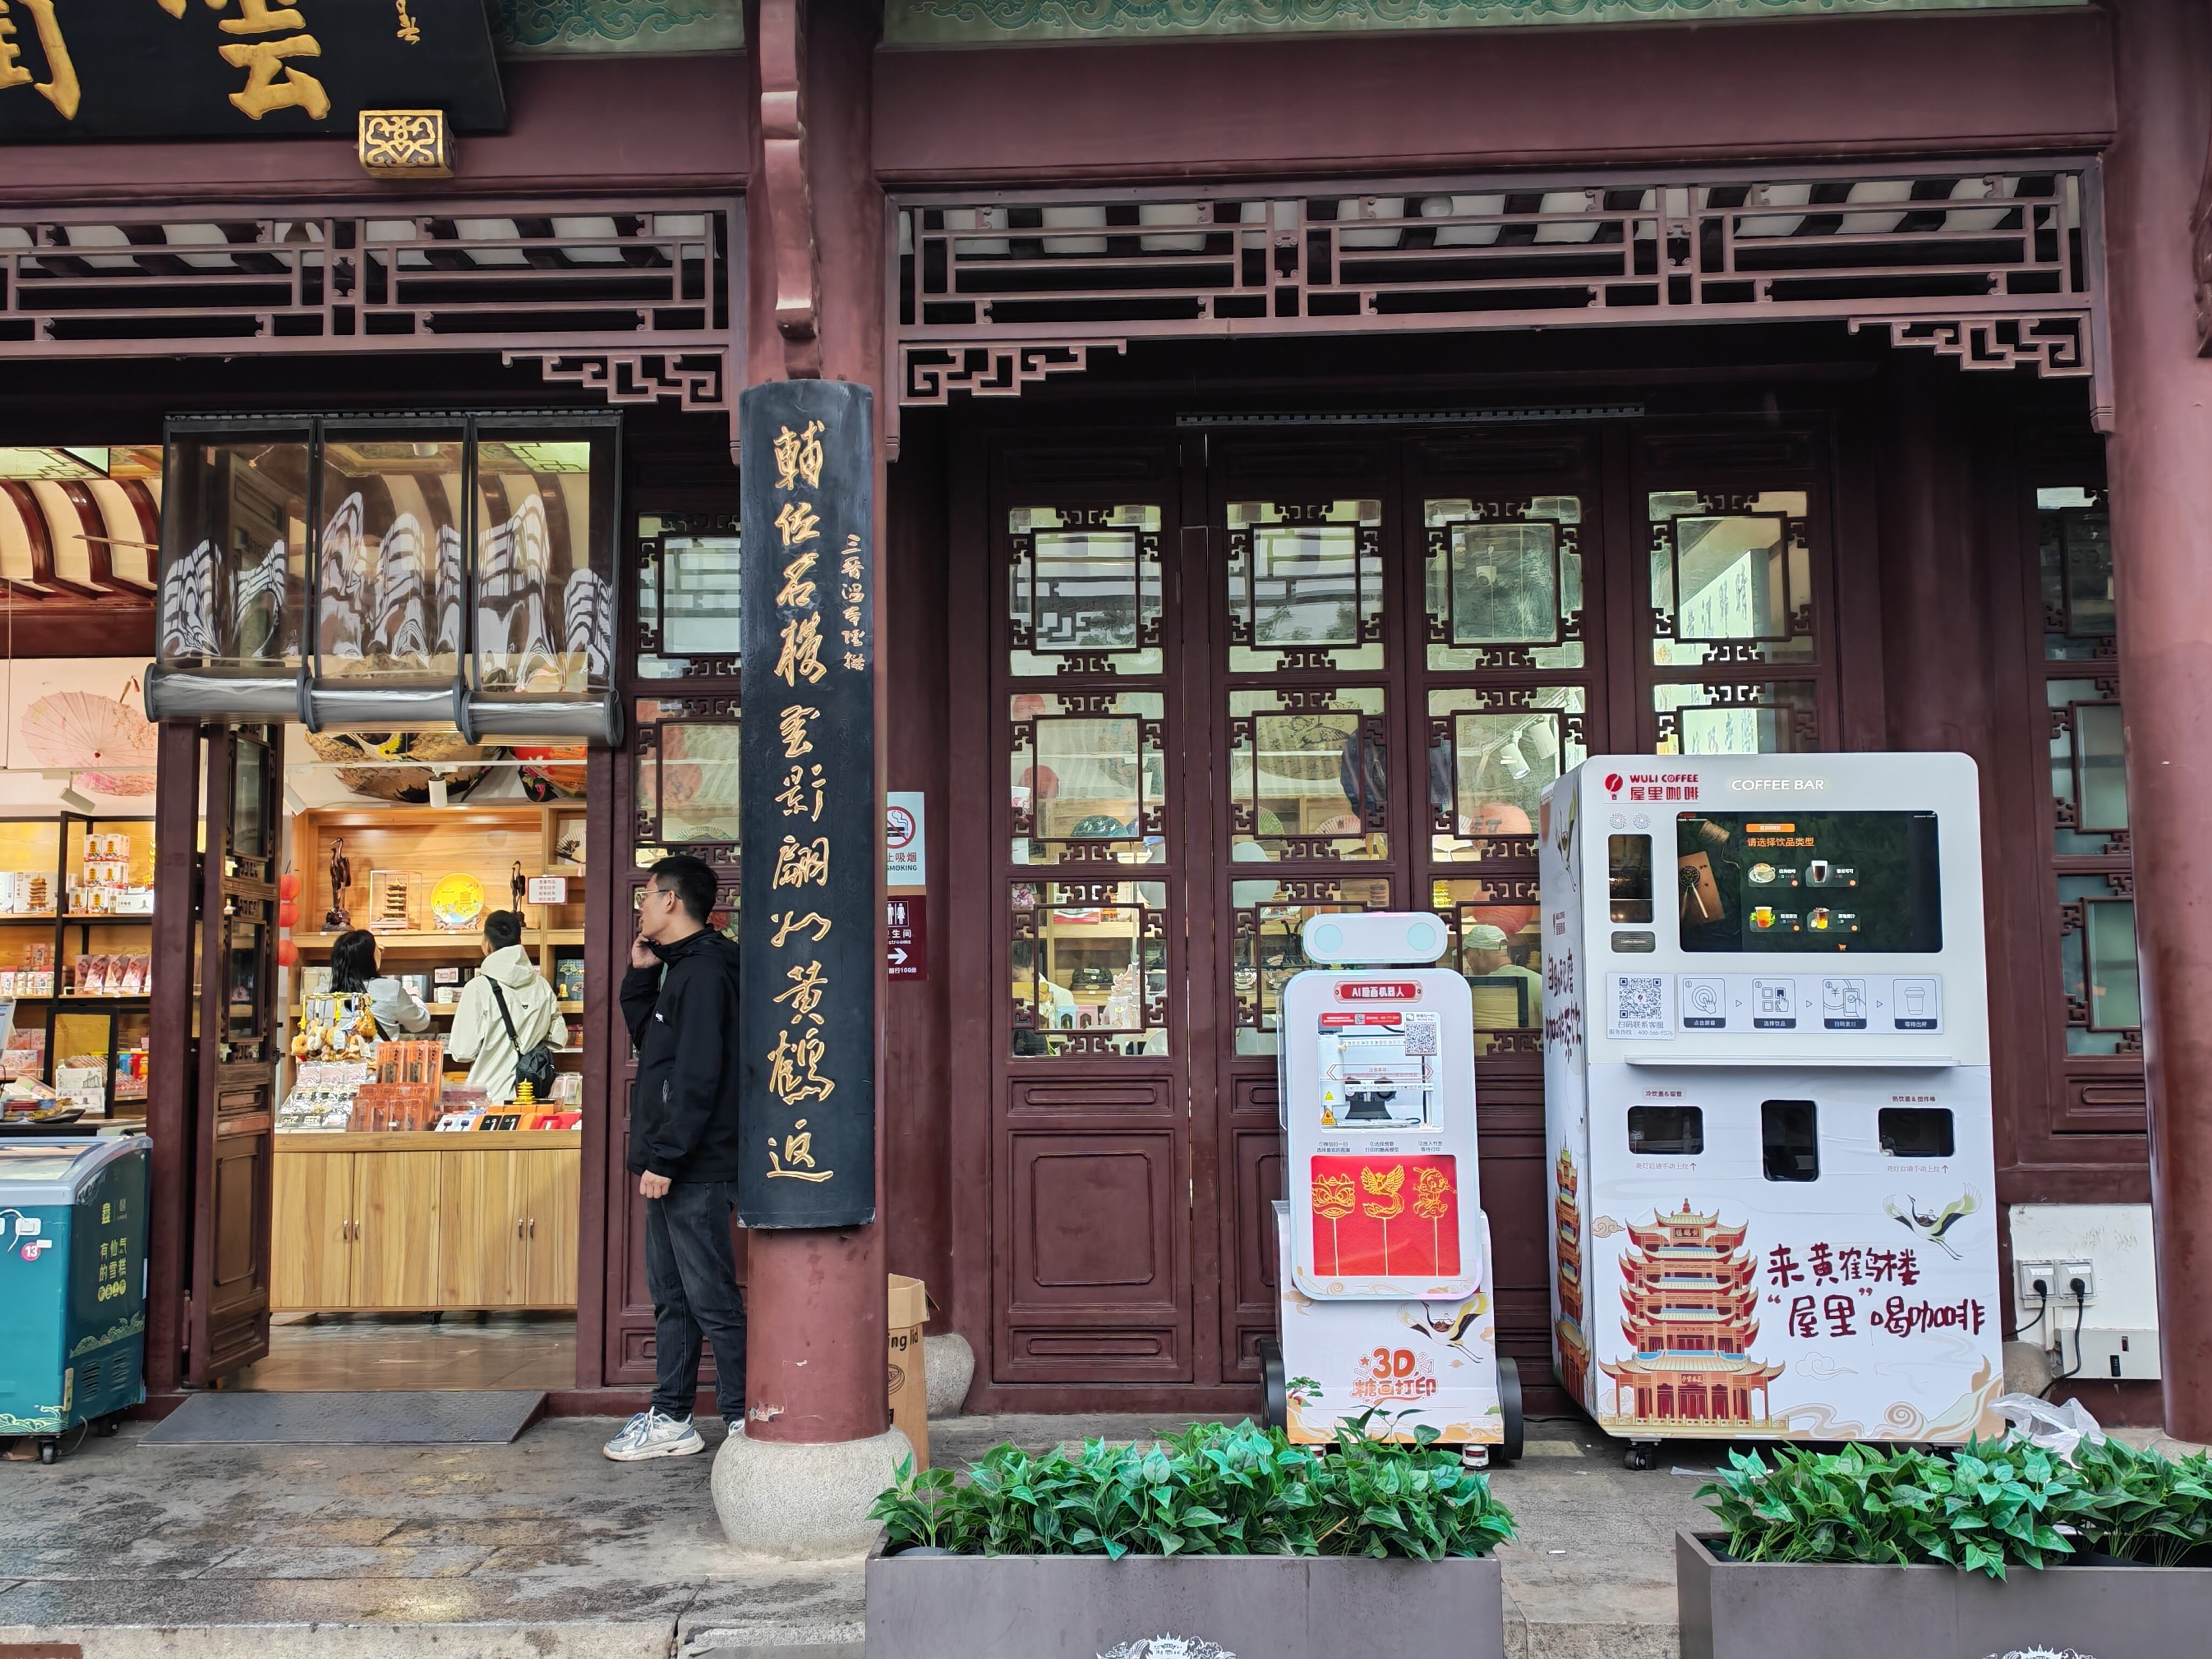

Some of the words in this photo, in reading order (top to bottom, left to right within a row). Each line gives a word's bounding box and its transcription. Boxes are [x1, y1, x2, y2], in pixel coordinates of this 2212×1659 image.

[1629, 774, 1658, 783] WULI
[1661, 774, 1699, 783] COFFEE
[1731, 779, 1790, 791] COFFEE
[1794, 779, 1824, 791] BAR
[1630, 786, 1699, 801] 屋里咖啡
[1747, 838, 1815, 847] 请选择饮品类型
[1618, 1021, 1664, 1029] 扫码联系客服
[25, 1245, 38, 1257] 13
[1767, 1242, 1920, 1289] 来黄鹤楼
[1372, 1347, 1416, 1379] 3D
[1351, 1377, 1437, 1398] 糖画打印
